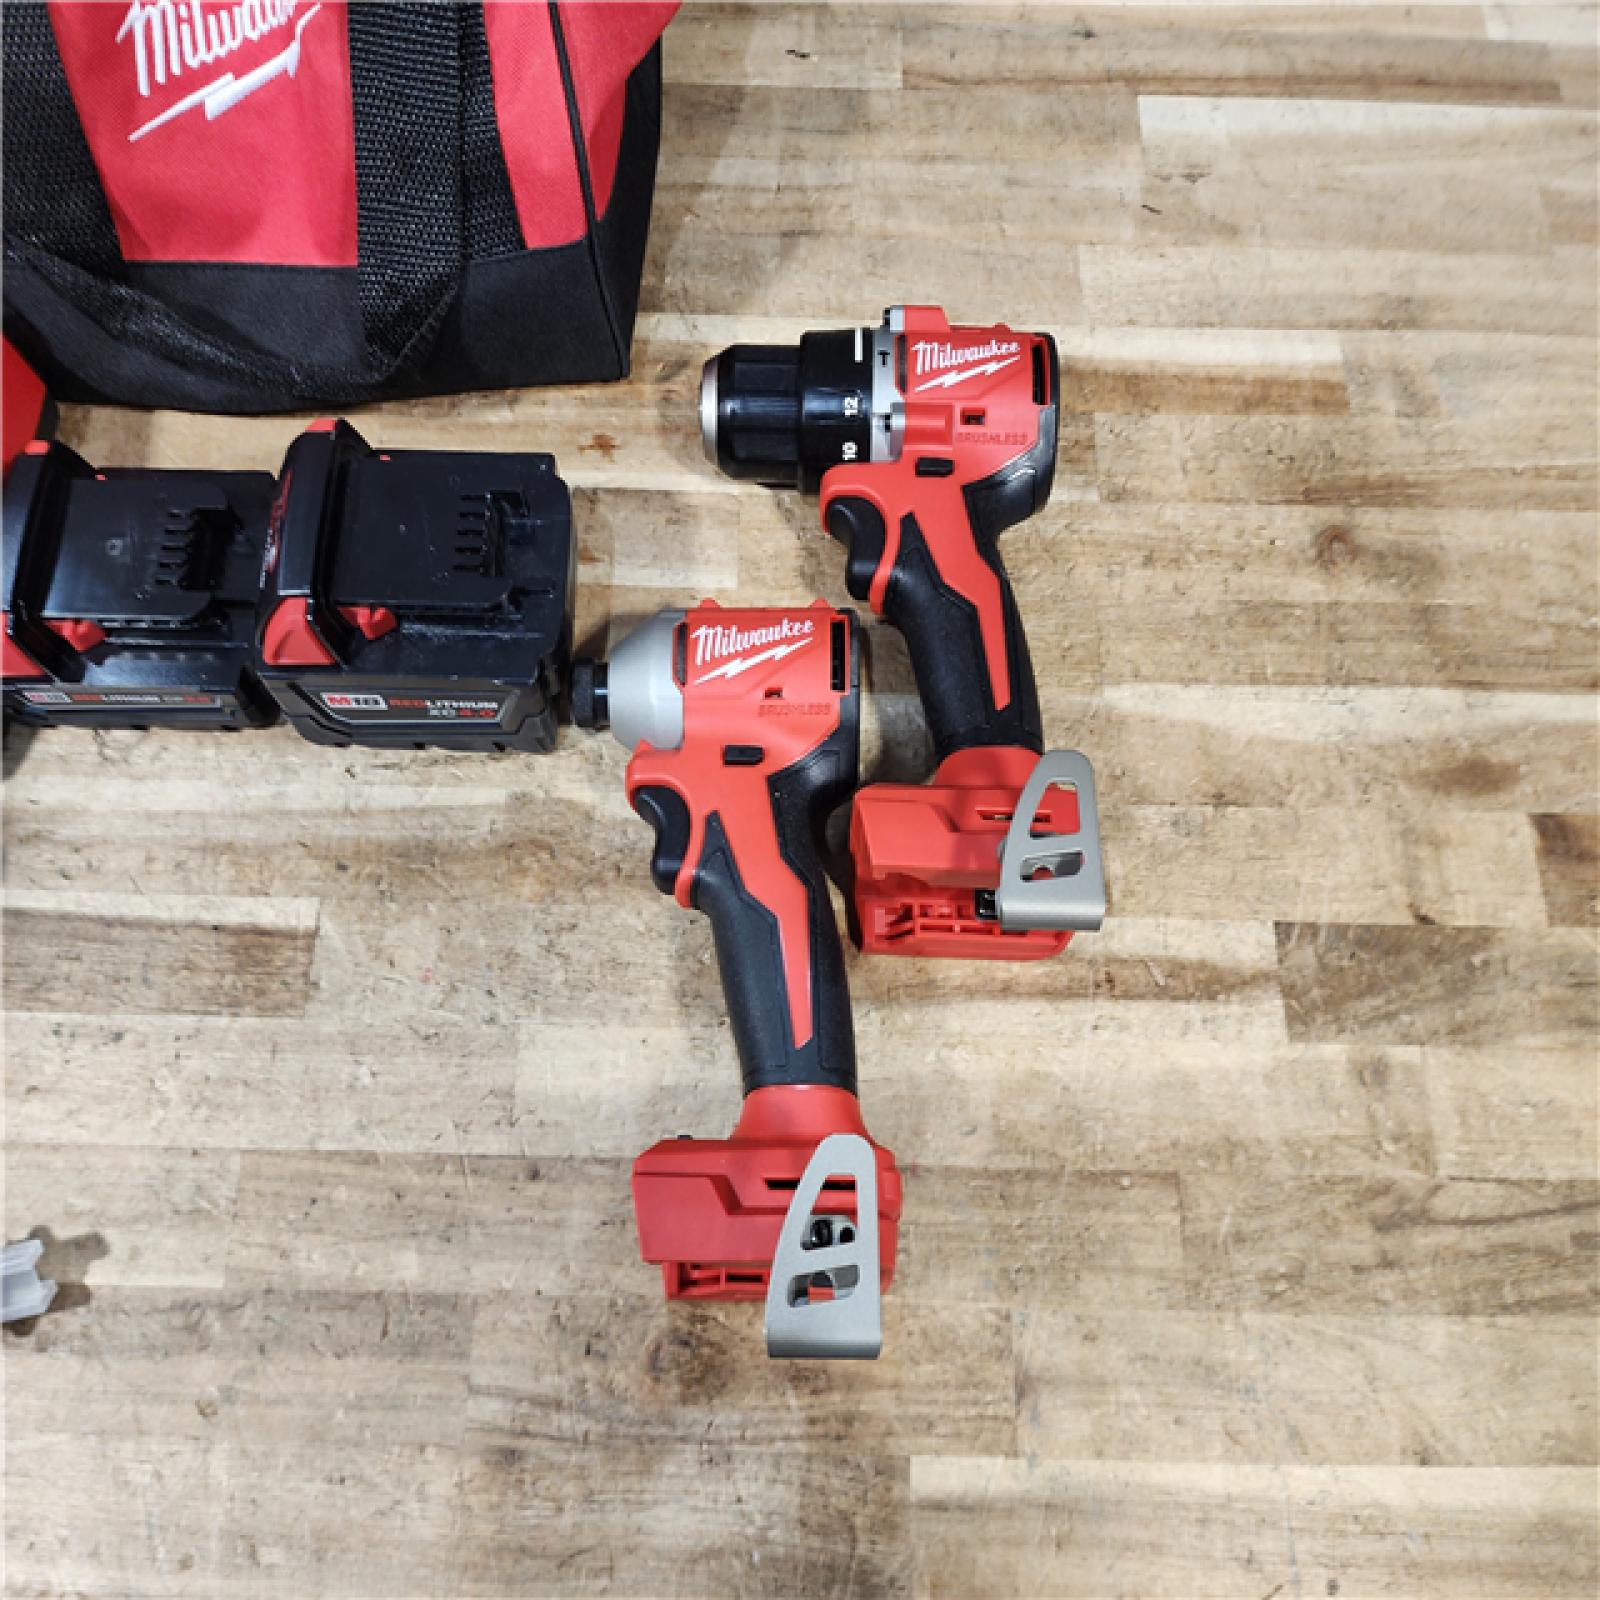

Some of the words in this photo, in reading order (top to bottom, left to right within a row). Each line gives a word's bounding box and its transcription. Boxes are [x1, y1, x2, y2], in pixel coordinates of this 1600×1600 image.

[911, 339, 1021, 376] Milwaukee
[956, 431, 1028, 446] BRUSHLESS
[690, 618, 815, 666] Milwaukee
[757, 702, 831, 717] BRUSHLESS
